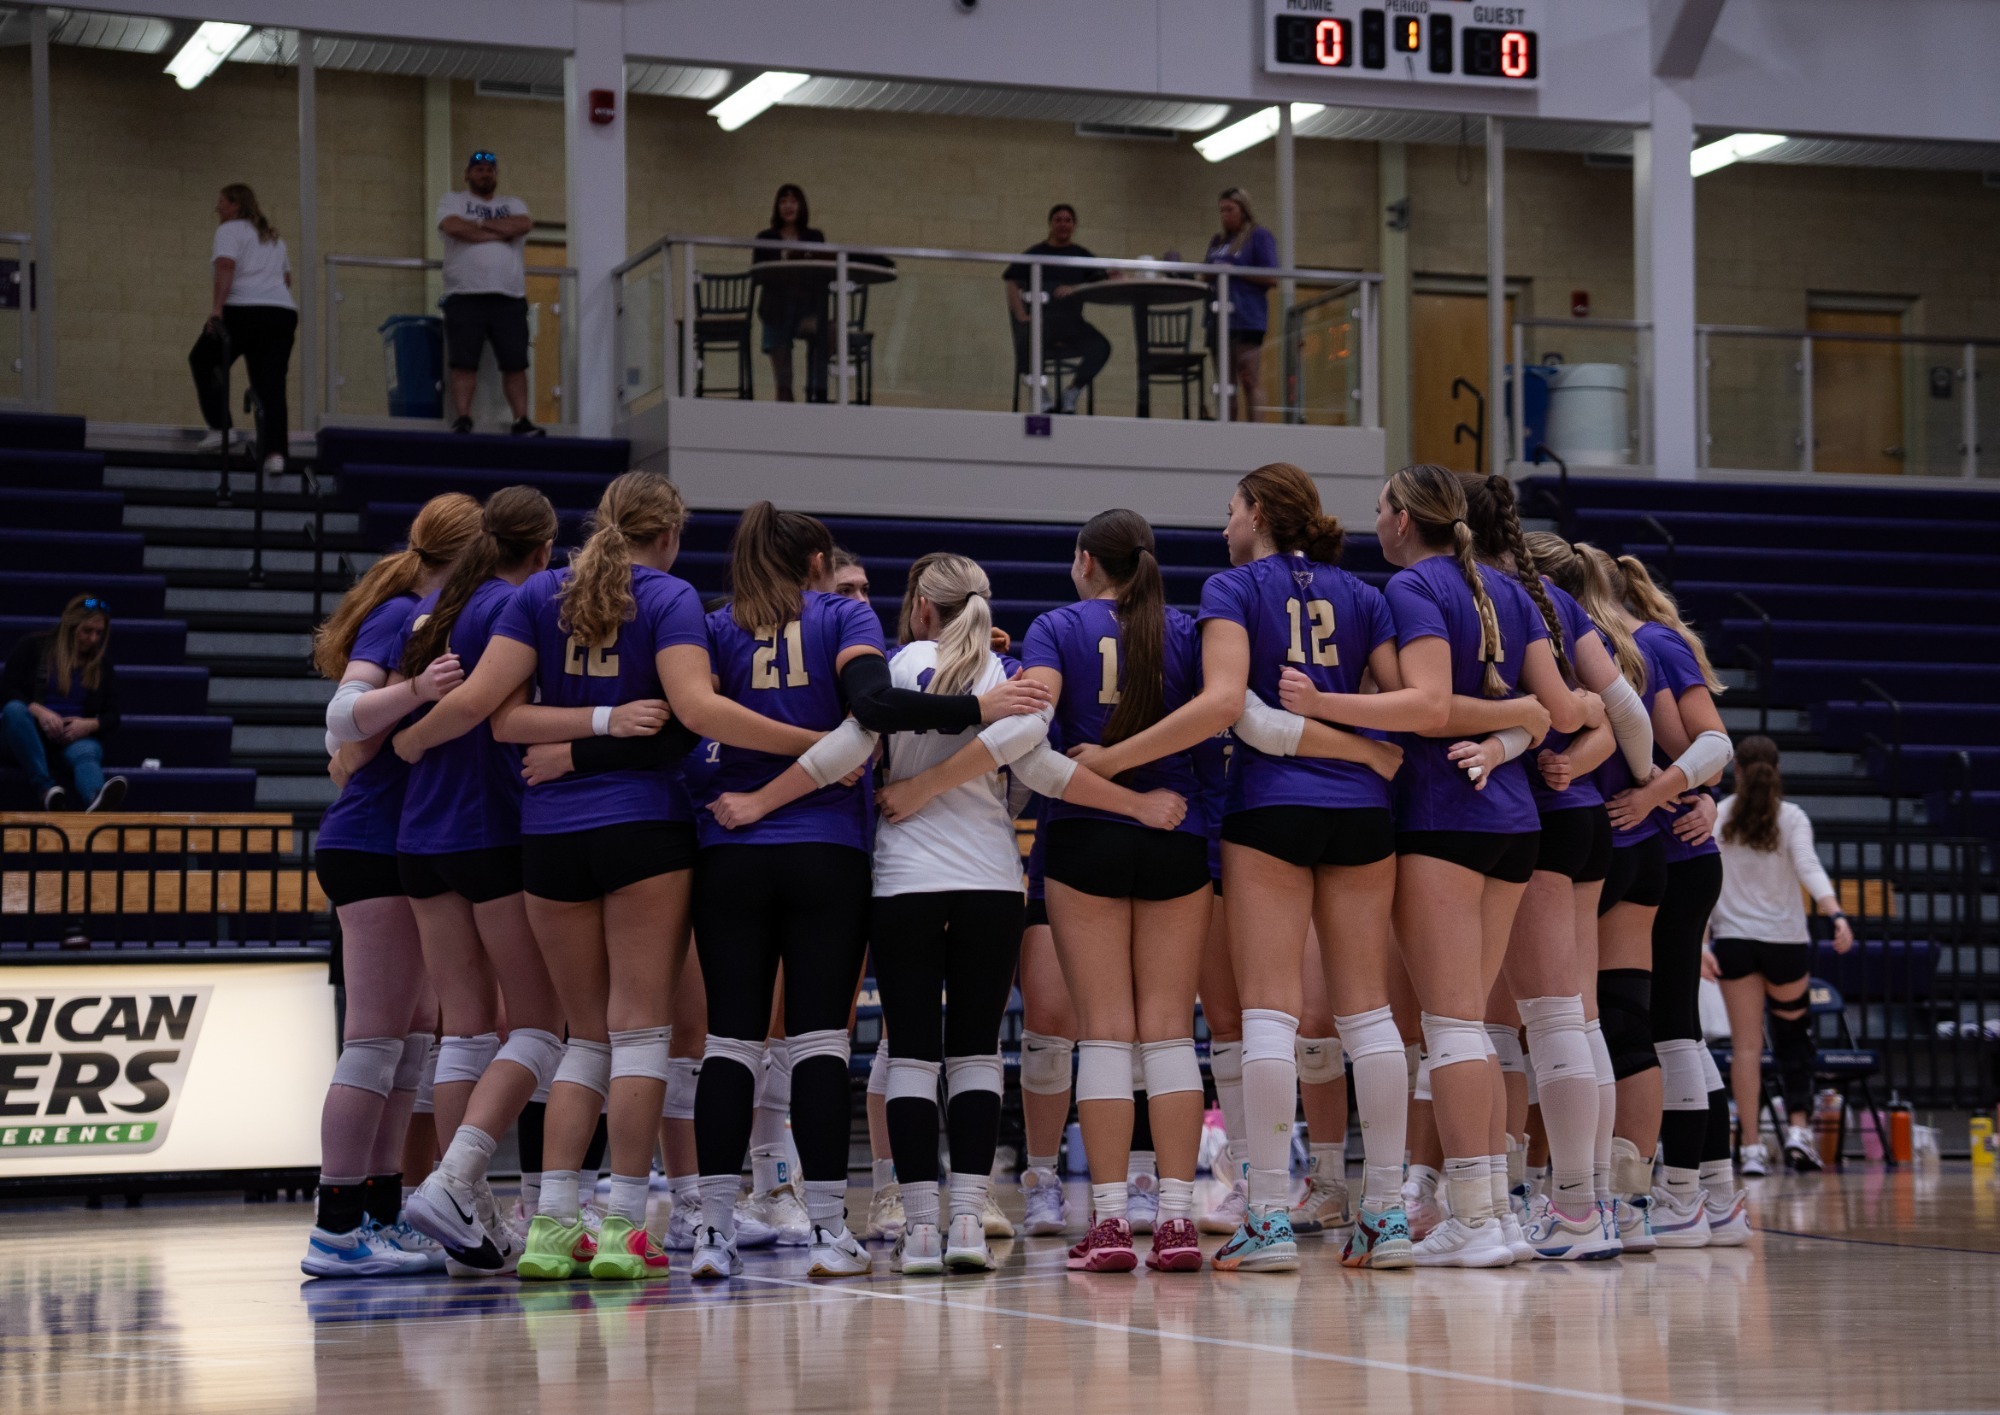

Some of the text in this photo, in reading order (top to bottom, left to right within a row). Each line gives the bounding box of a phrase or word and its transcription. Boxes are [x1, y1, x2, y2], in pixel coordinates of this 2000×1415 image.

[1286, 0, 1334, 13] HOME
[1385, 1, 1430, 14] PERIOD
[1473, 7, 1525, 25] GUEST
[1315, 19, 1344, 67] 0
[1407, 20, 1419, 51] 1
[1500, 31, 1529, 78] 0
[1286, 596, 1340, 667] 12
[750, 619, 811, 691] 21
[2, 1125, 146, 1145] ERENCE
